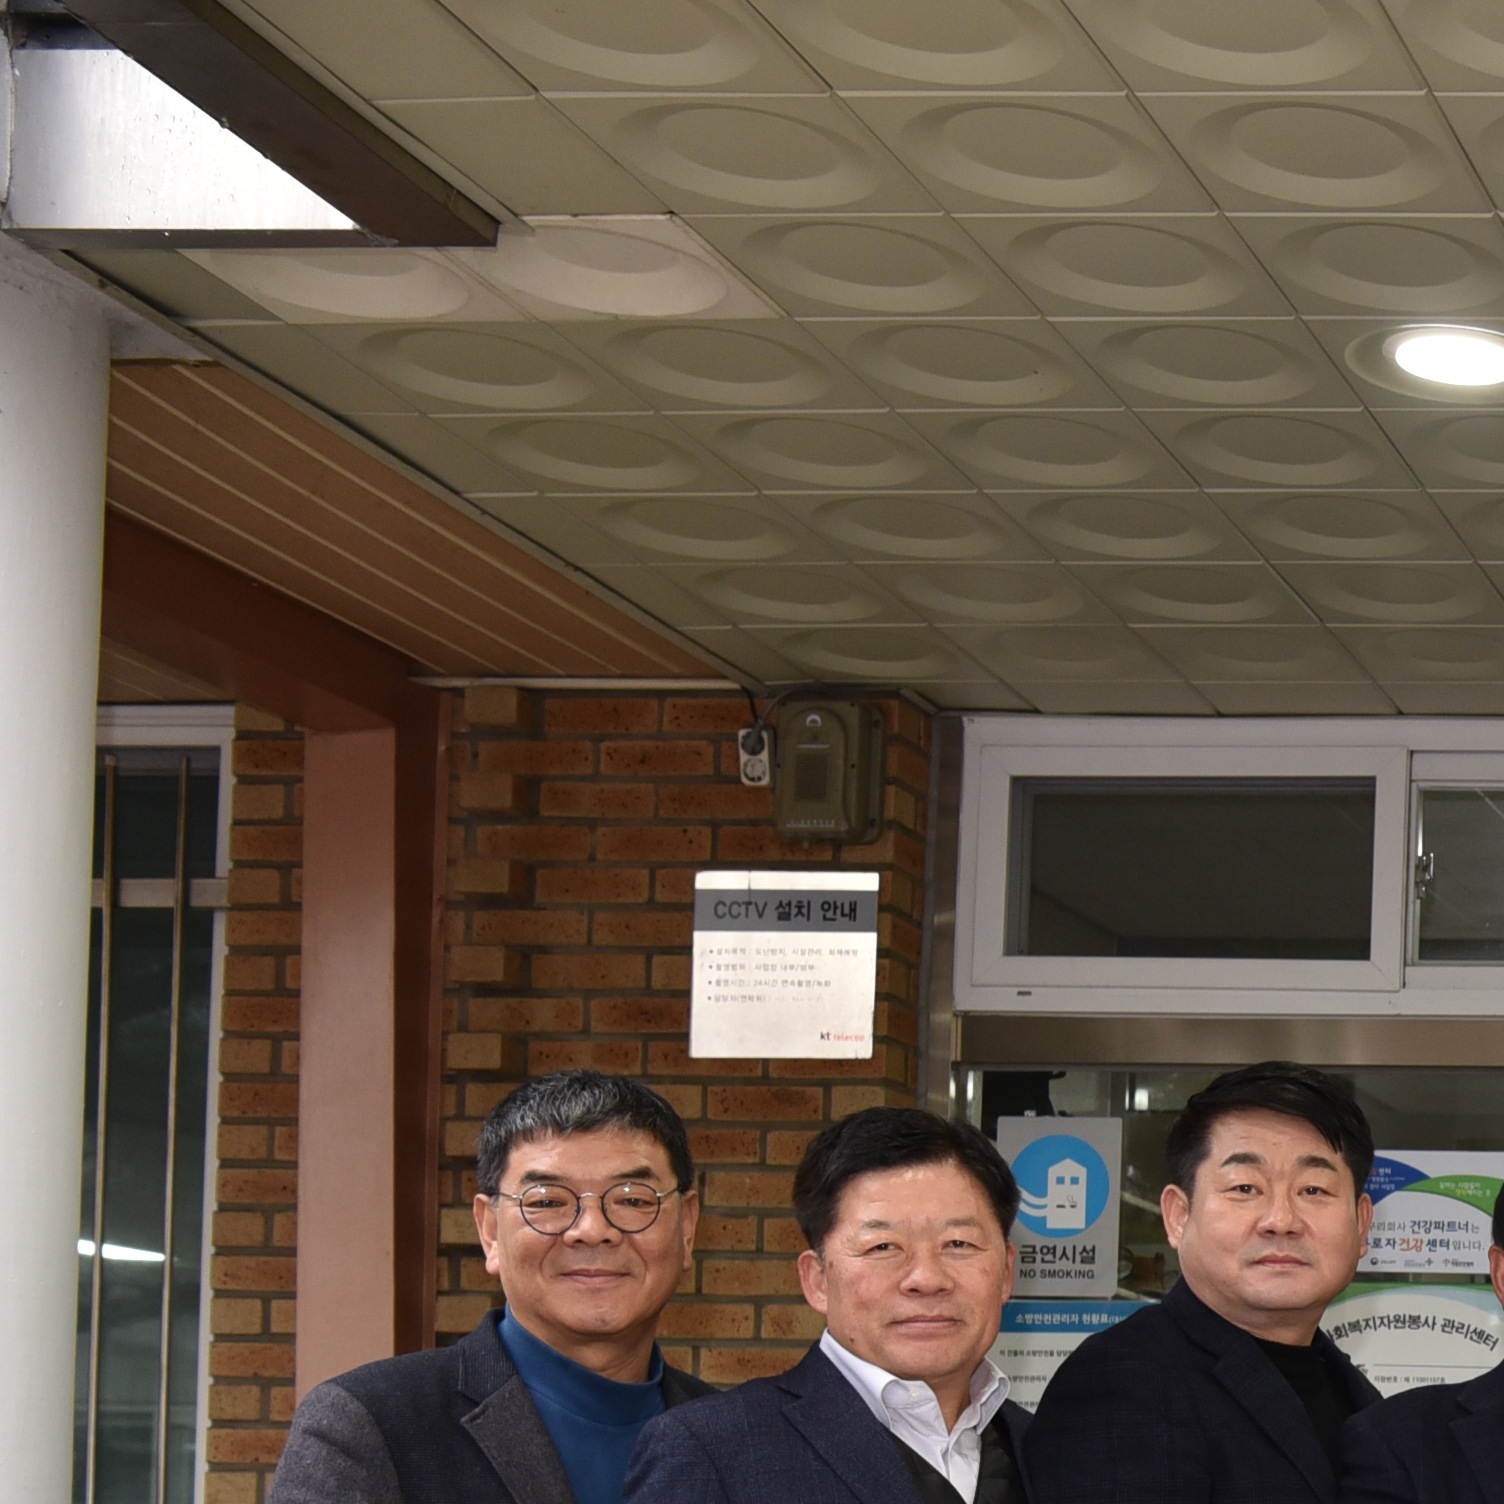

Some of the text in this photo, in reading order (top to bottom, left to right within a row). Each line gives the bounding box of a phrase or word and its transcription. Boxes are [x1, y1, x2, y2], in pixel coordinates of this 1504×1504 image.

[714, 899, 857, 923] CCTV 설치 안내
[820, 1032, 831, 1040] kt
[1019, 1245, 1096, 1264] 금연시설
[1020, 1269, 1094, 1279] NO SMOKING
[1015, 1313, 1079, 1324] 소방안전관리자
[1441, 1318, 1499, 1351] 관리센터
